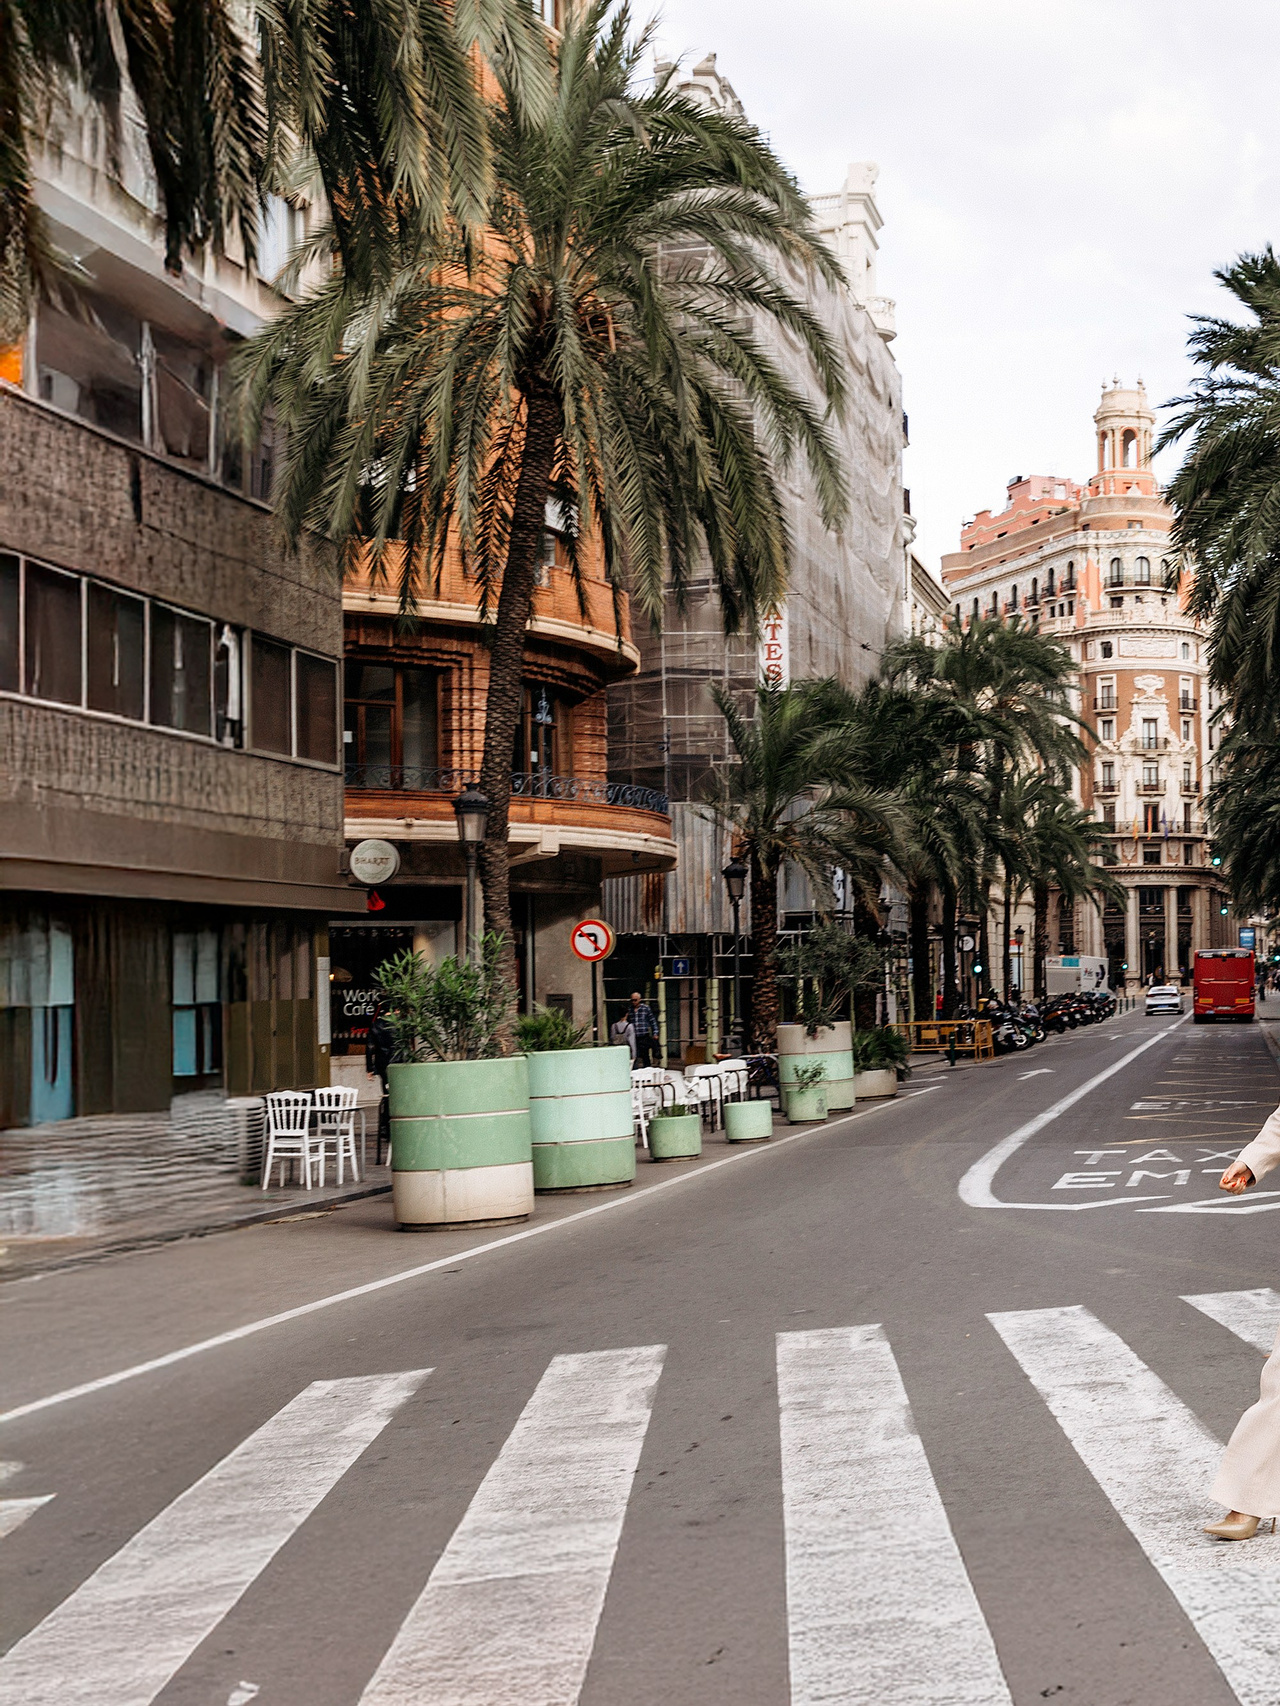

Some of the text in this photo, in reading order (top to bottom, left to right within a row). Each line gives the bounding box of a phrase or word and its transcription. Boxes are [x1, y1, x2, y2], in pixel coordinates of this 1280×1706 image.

[342, 989, 380, 1002] Work
[343, 1003, 375, 1016] Café
[1074, 1148, 1243, 1164] TAX
